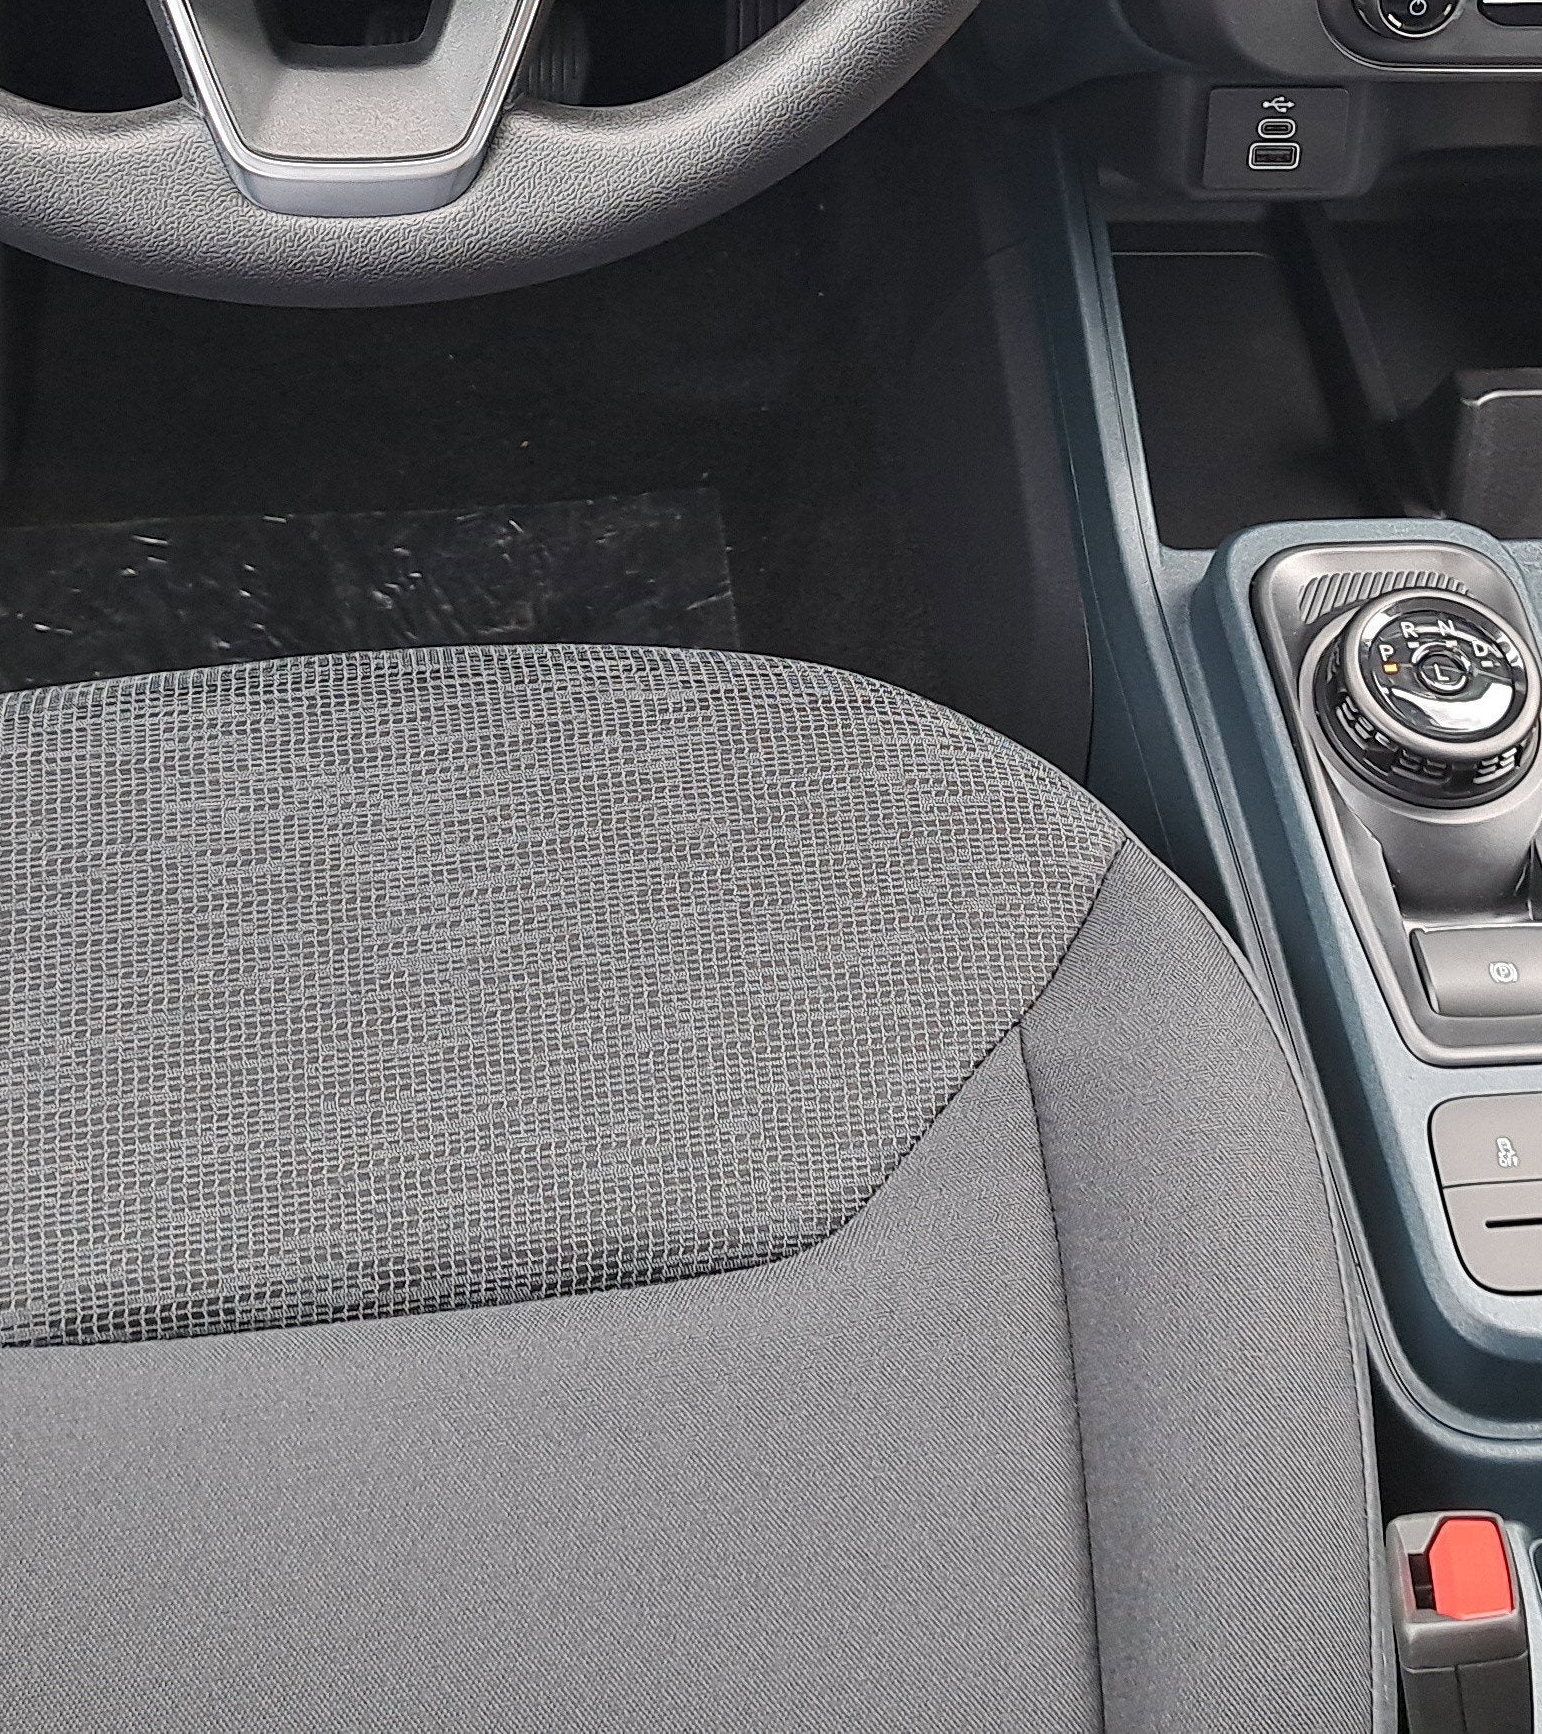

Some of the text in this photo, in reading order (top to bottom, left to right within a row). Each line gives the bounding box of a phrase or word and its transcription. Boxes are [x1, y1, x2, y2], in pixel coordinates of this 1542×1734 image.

[1378, 619, 1490, 661] P R N D
[1433, 663, 1449, 681] L
